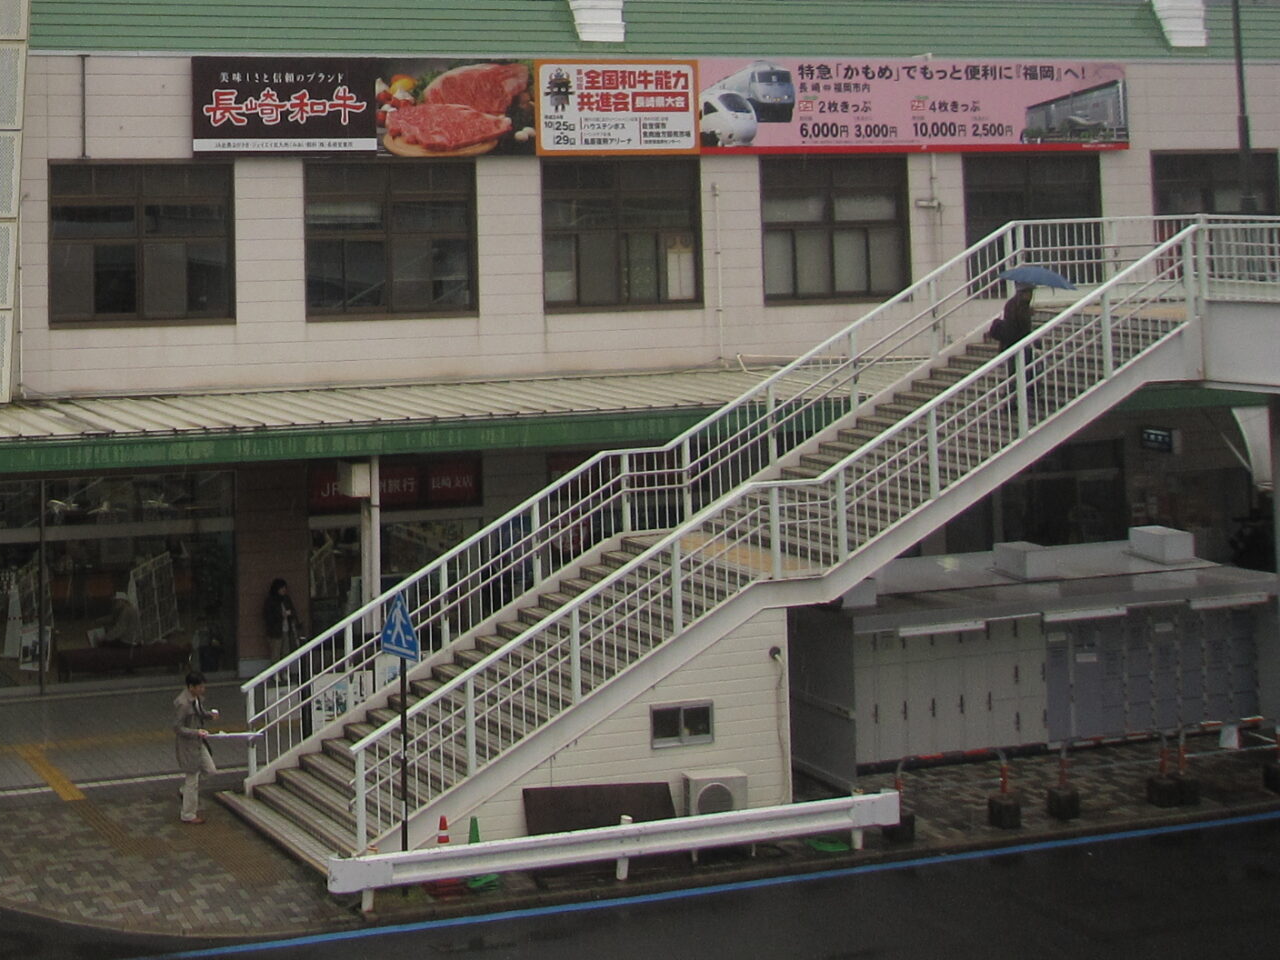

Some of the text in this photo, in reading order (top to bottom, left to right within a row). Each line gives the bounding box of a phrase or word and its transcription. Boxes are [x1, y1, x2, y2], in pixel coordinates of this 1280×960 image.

[219, 72, 345, 83] 美味しさと信頼のブランド
[584, 69, 689, 90] 全国和牛能力
[203, 86, 367, 127] 長崎和牛
[577, 92, 631, 112] 共進会
[818, 100, 872, 113] 2枚きっぷ
[929, 100, 980, 113] 4枚きっぷ
[800, 123, 898, 139] 6,000円 3,000円
[913, 122, 1013, 139] 10,000円 2,500円
